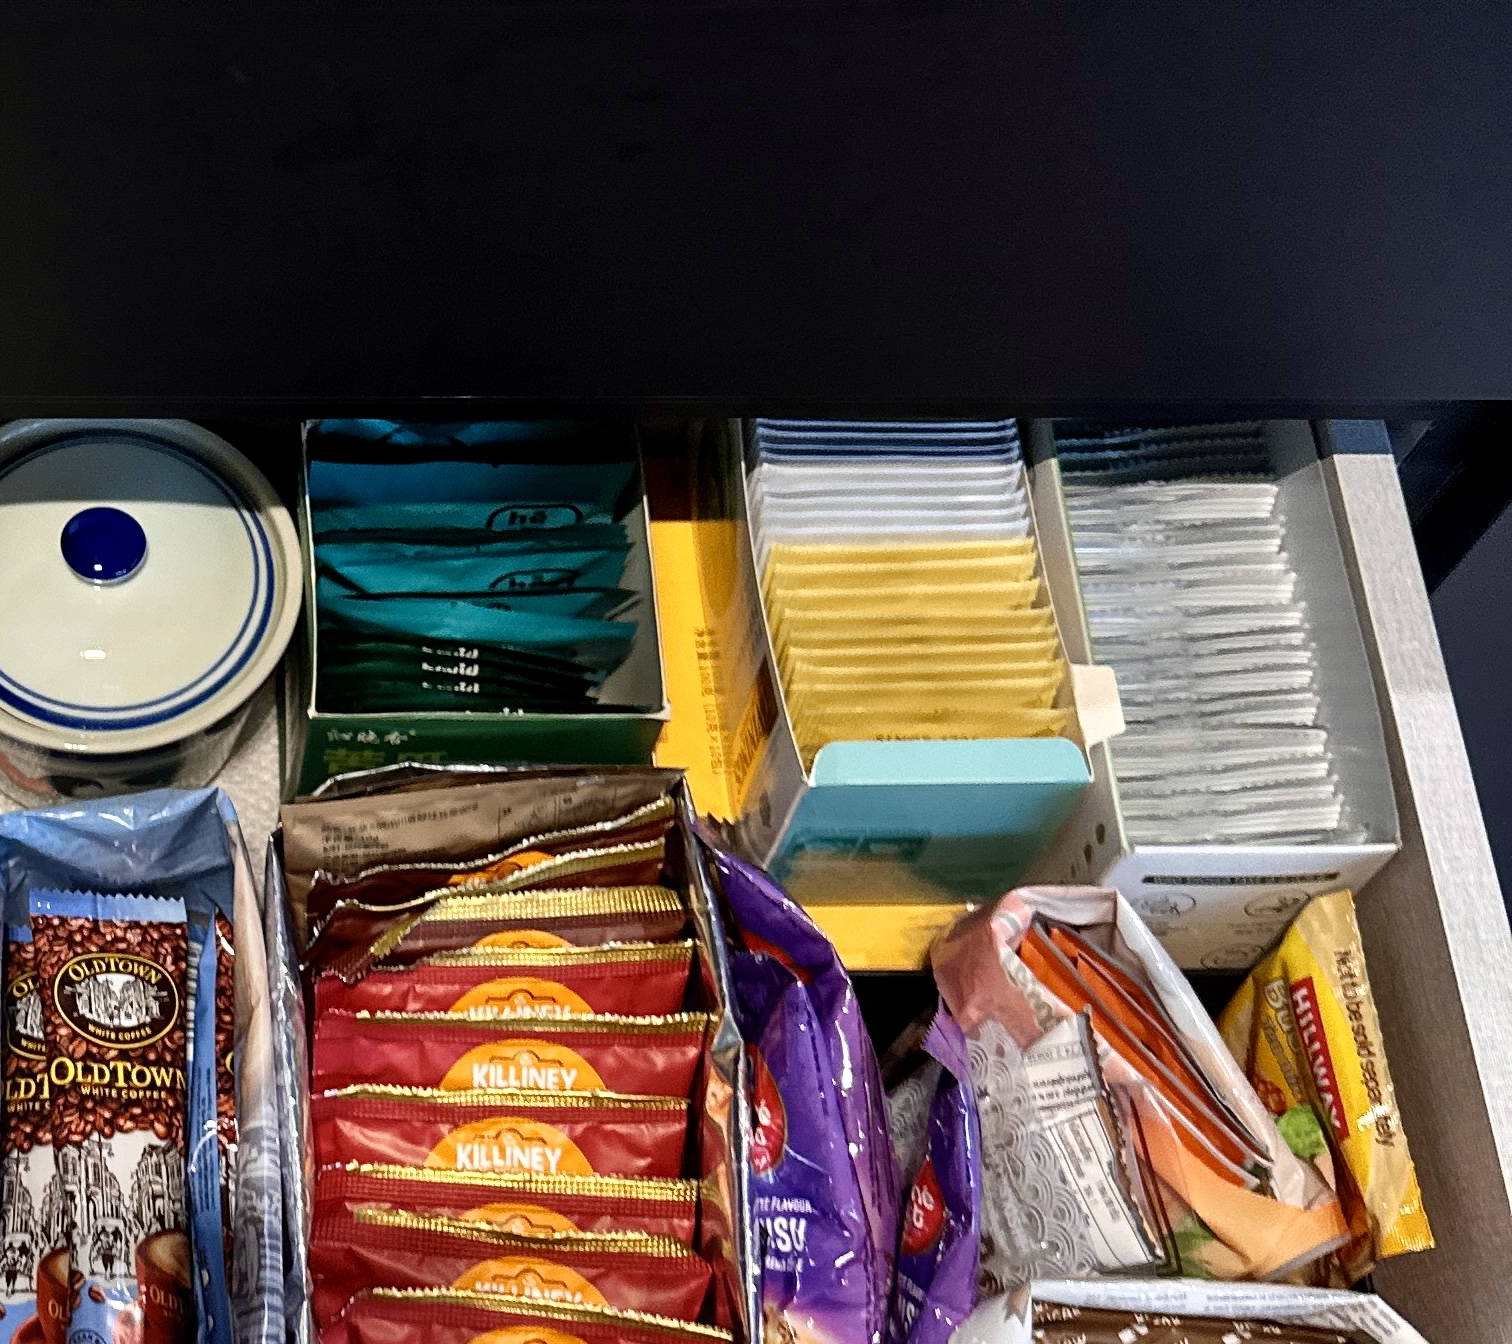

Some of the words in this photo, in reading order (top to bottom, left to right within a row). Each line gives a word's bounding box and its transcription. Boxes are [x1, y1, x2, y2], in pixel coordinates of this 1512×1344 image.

[1291, 985, 1342, 1130] HILLWAY
[471, 1062, 579, 1090] KILLINEY
[80, 1085, 117, 1098] WHITE
[121, 1088, 167, 1100] COFFEE
[455, 1142, 563, 1175] KILLINEY
